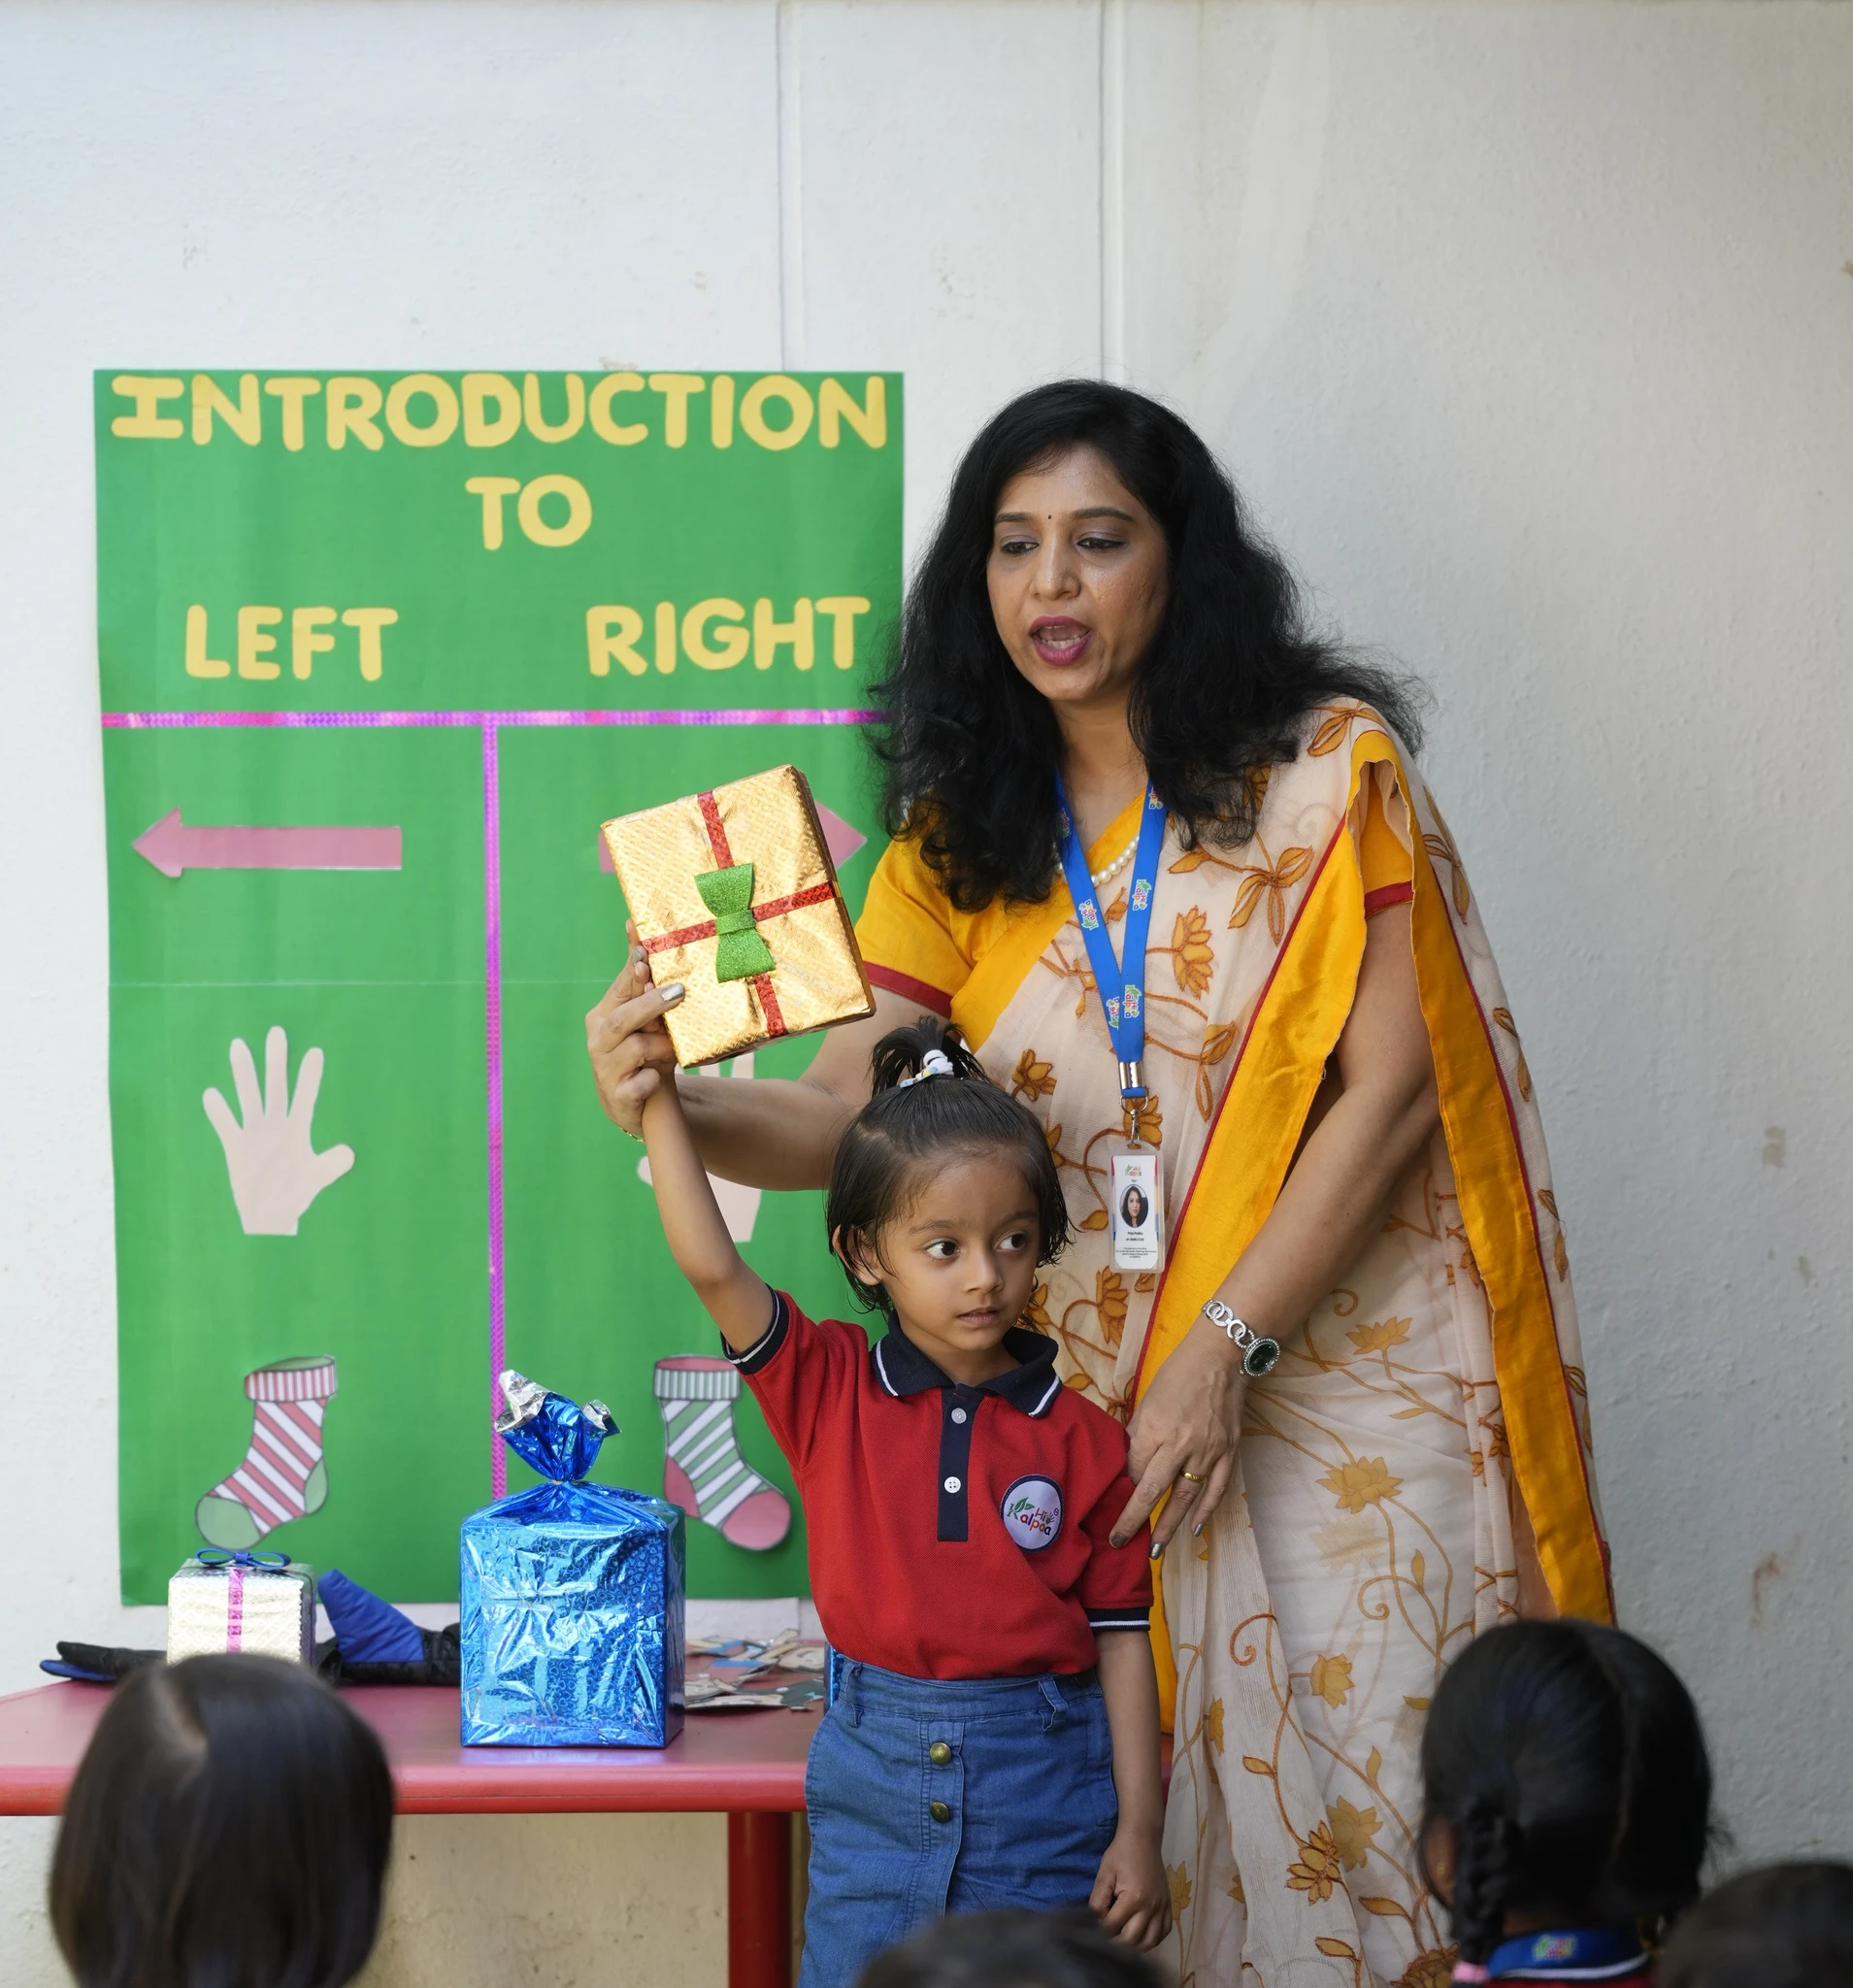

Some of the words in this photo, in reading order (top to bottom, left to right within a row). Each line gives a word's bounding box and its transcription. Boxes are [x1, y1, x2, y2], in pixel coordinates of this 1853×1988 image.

[111, 373, 887, 451] INTRODUCTION
[465, 474, 592, 550] TO
[184, 604, 399, 681] LEFT
[586, 596, 871, 677] RIGHT
